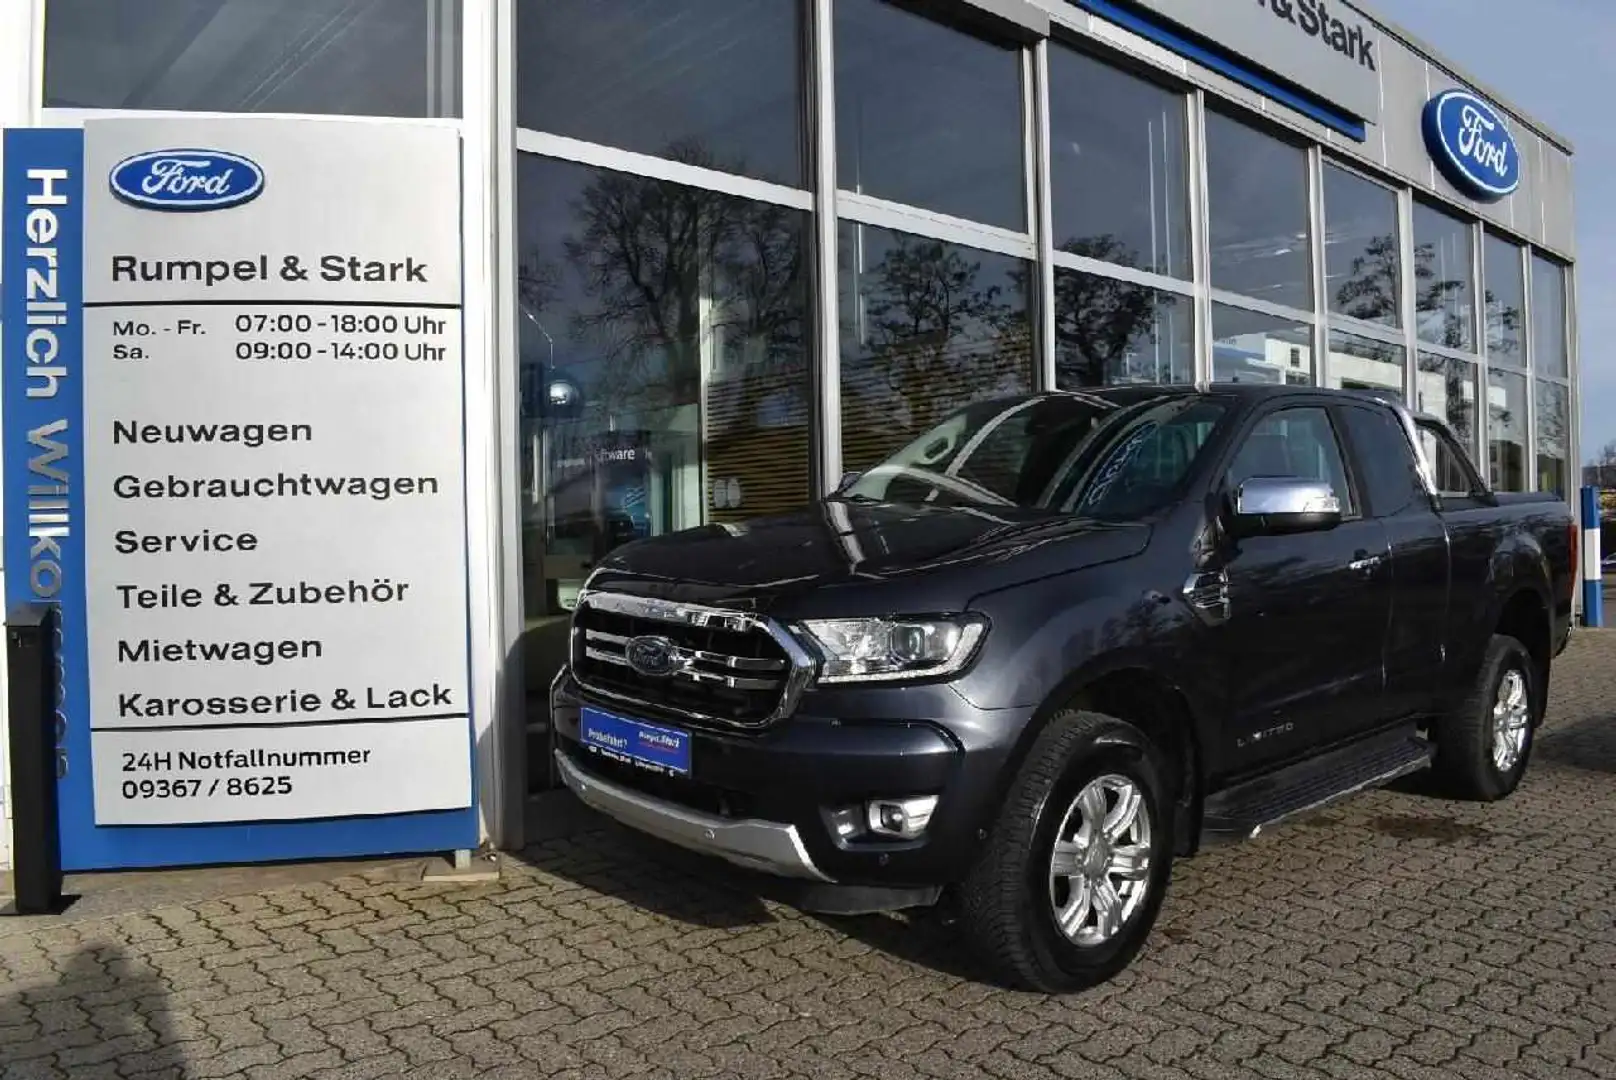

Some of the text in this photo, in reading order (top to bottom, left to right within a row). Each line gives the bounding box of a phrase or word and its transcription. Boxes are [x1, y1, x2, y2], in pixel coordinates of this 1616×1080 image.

[1458, 104, 1508, 177] Ford
[141, 158, 234, 195] Ford
[112, 254, 427, 287] Rumpel & Stark
[112, 319, 157, 337] Mo.
[177, 319, 207, 336] Fr.
[235, 314, 312, 333] 07:00
[404, 315, 446, 335] Uhr
[112, 343, 150, 360] Sa.
[235, 341, 312, 360] 09:00
[404, 343, 446, 361] Uhr
[113, 420, 312, 448] Neuwagen
[26, 169, 69, 780] Herzlich Willko
[113, 472, 438, 501] Gebrauchtwagen
[114, 529, 258, 555] Service
[115, 578, 409, 609] Teile & Zubehör
[118, 639, 322, 666] Mietwagen
[118, 683, 453, 718] Karosserie & Lack
[122, 749, 371, 772] 24H Notfallnummer
[121, 775, 293, 800] 09367 / 8625
